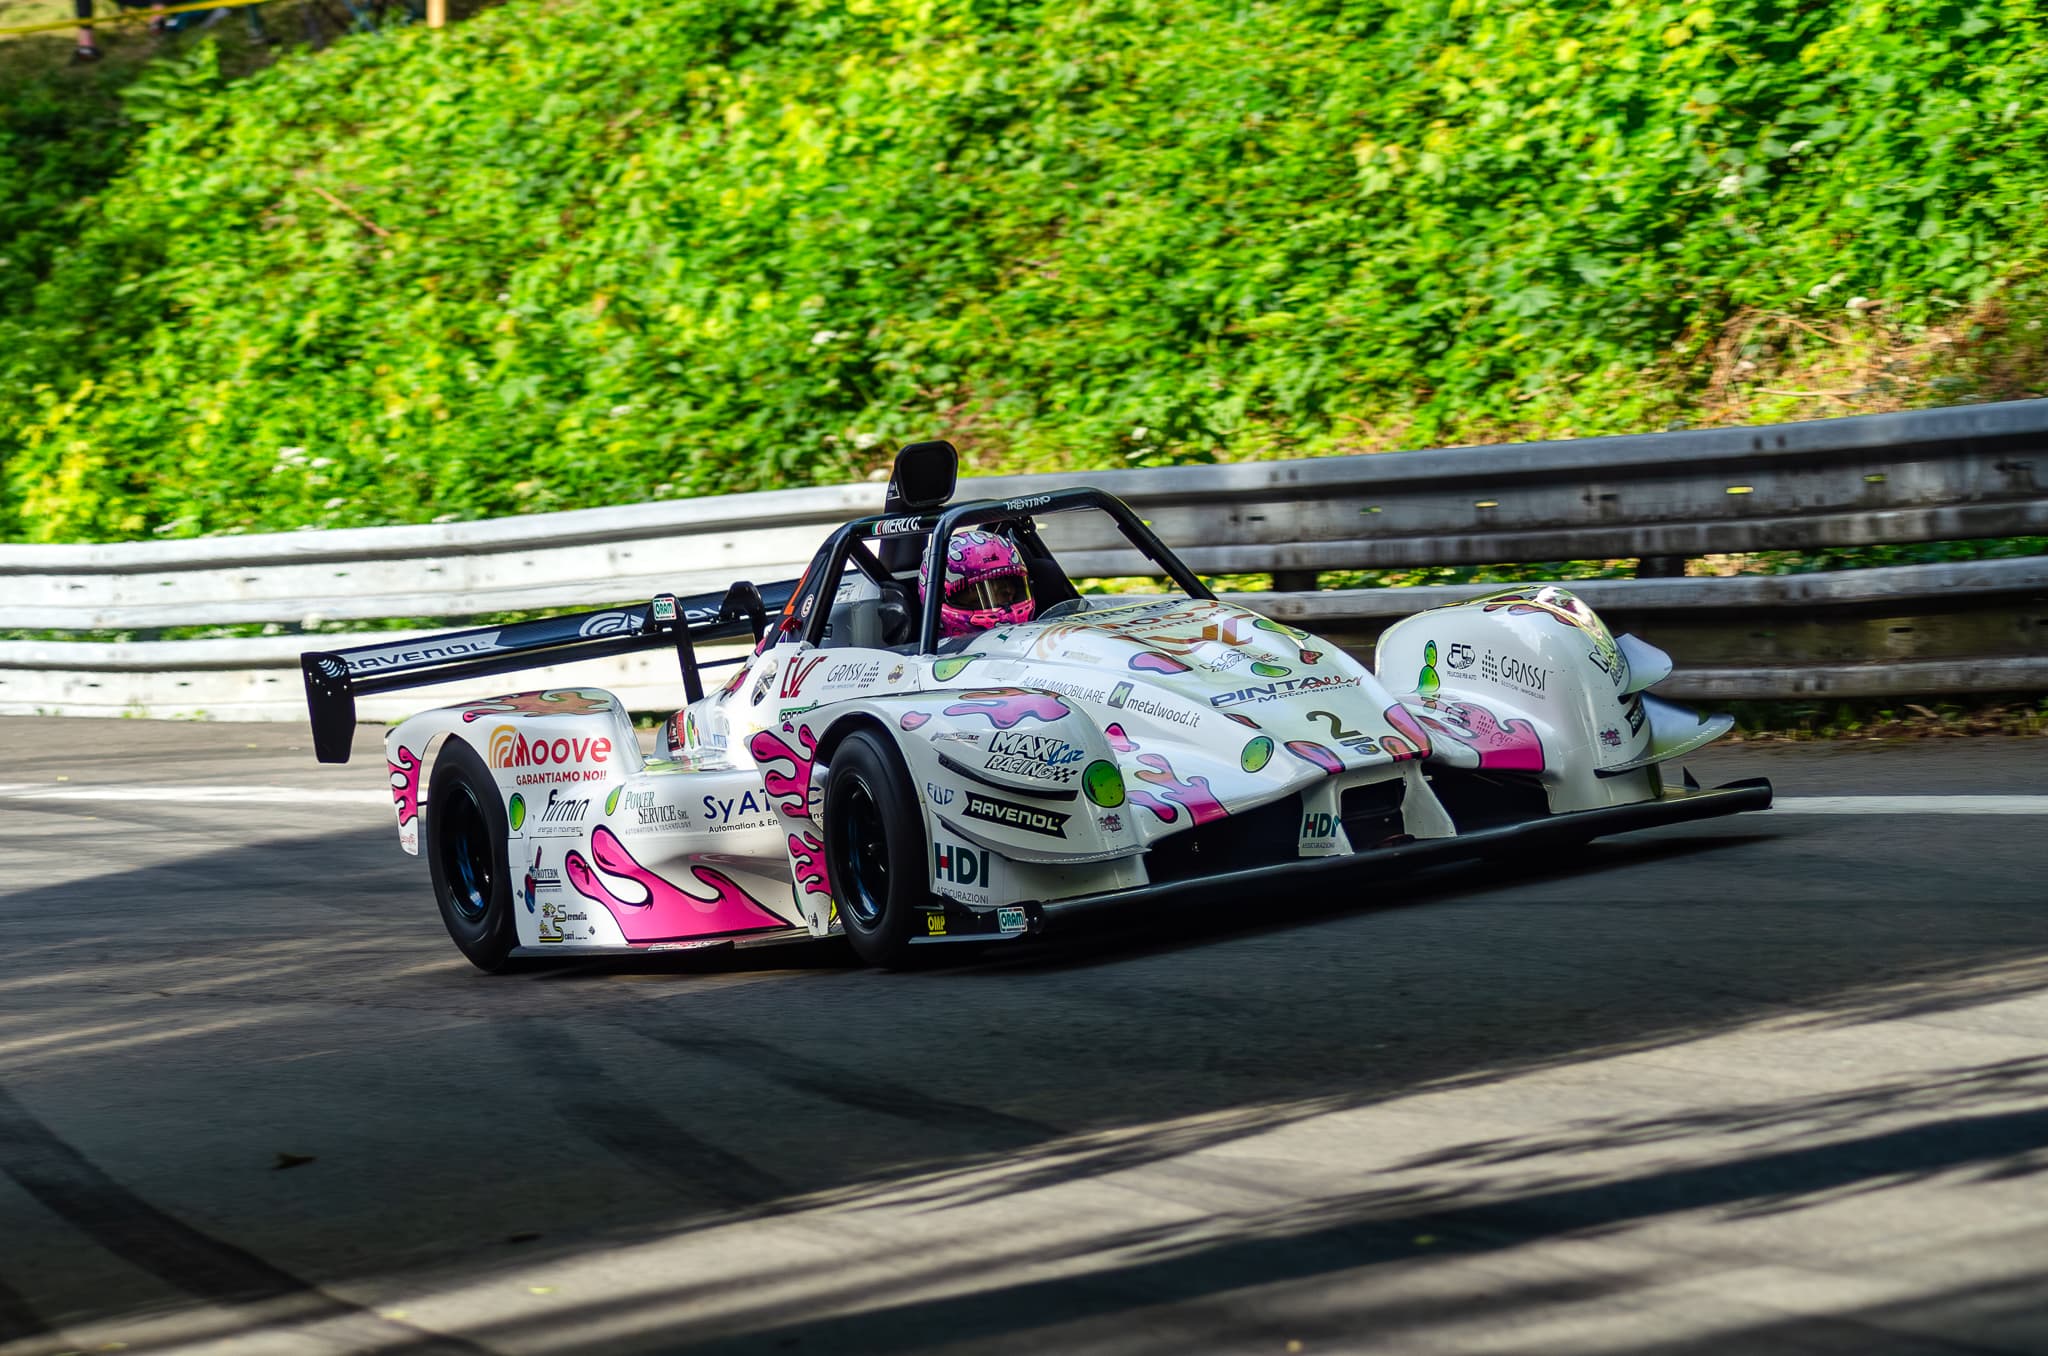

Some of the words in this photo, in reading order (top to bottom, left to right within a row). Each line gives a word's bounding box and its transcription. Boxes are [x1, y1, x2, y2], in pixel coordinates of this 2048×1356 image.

[1003, 495, 1051, 511] TRENTINO
[827, 663, 866, 683] GRASSI
[1501, 655, 1546, 691] GRASSI
[1022, 676, 1046, 689] ALMA
[1049, 680, 1106, 704] IMMOBILIARE
[1210, 677, 1327, 707] PINTA
[1258, 683, 1355, 703] Motorsport
[1127, 697, 1201, 728] metalwood.it
[1306, 710, 1363, 739] 2
[510, 732, 612, 766] Moove
[988, 731, 1065, 763] MAXI
[516, 770, 581, 786] GARANTIAMO
[583, 770, 607, 782] NO!!
[984, 755, 1056, 780] RACING
[624, 791, 655, 810] POWER
[638, 804, 677, 825] SERVICE
[709, 821, 756, 834] Automation
[759, 820, 765, 828] &
[970, 799, 1059, 832] RAVENOL
[1302, 813, 1340, 838] HDI
[934, 842, 990, 888] HDI
[928, 916, 946, 931] OMP
